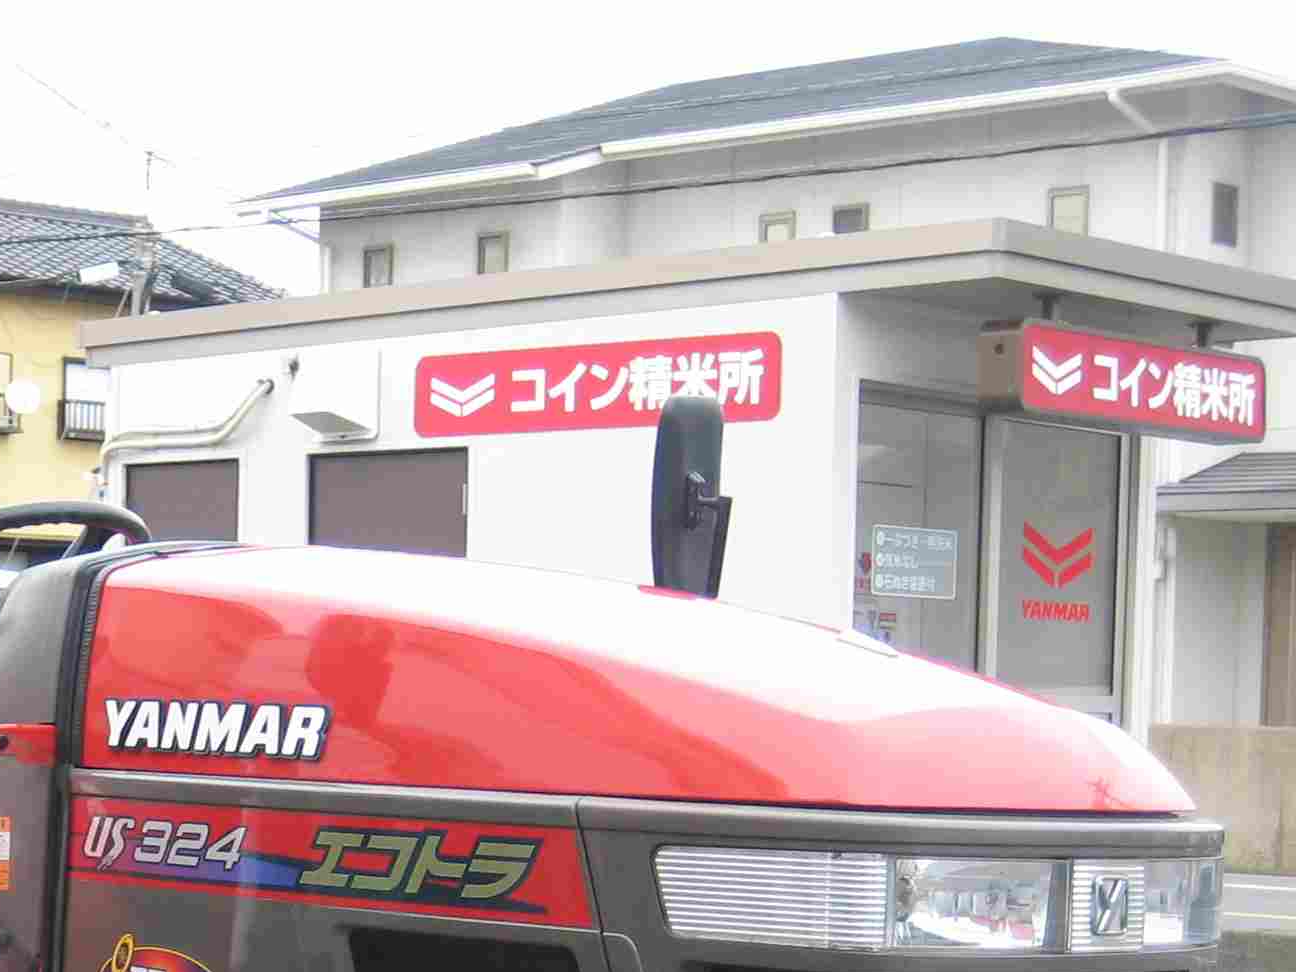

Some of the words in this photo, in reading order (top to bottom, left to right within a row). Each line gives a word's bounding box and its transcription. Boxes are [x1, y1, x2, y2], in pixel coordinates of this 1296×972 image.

[509, 348, 765, 413] コイン精米所
[1092, 354, 1256, 427] コイン精米所
[1022, 599, 1089, 622] YANMAR
[104, 698, 331, 761] YANMAR
[82, 815, 136, 871] US
[134, 820, 248, 871] 324
[300, 828, 540, 900] エコトラ
